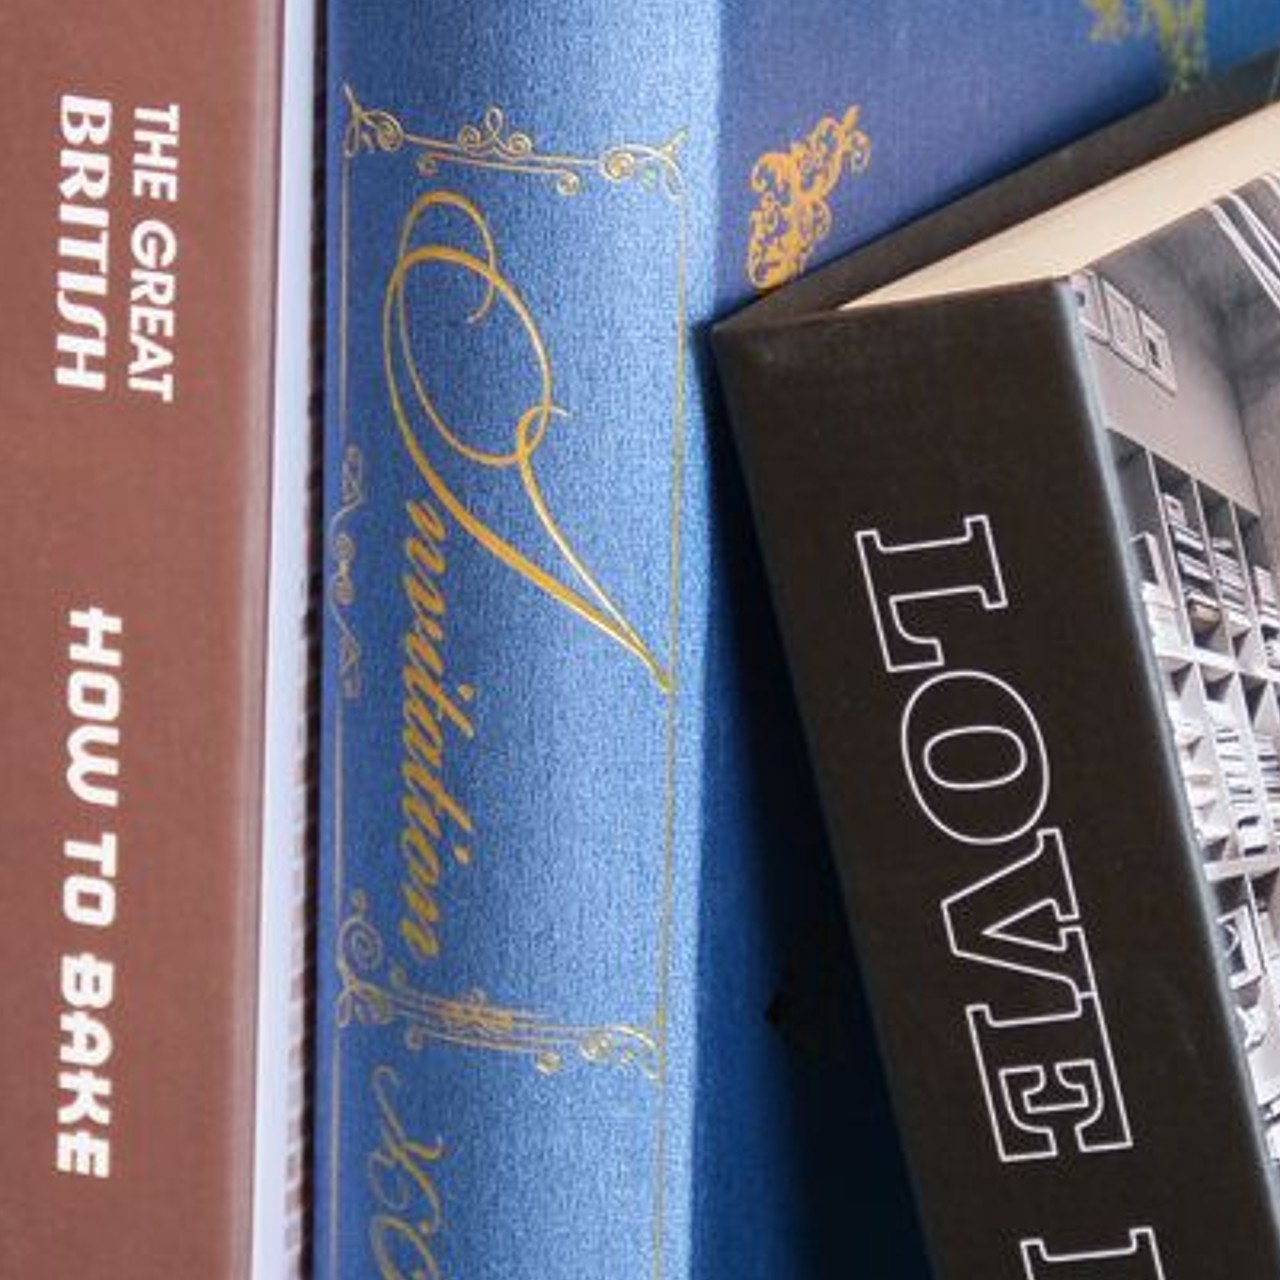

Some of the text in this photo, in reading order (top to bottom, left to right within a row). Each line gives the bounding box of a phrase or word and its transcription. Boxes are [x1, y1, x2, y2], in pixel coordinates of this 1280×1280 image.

[54, 94, 112, 391] BRITISH
[127, 103, 180, 402] THE GREAT
[56, 606, 123, 1179] HOW TO BAKE
[855, 514, 1133, 1163] LOVE
